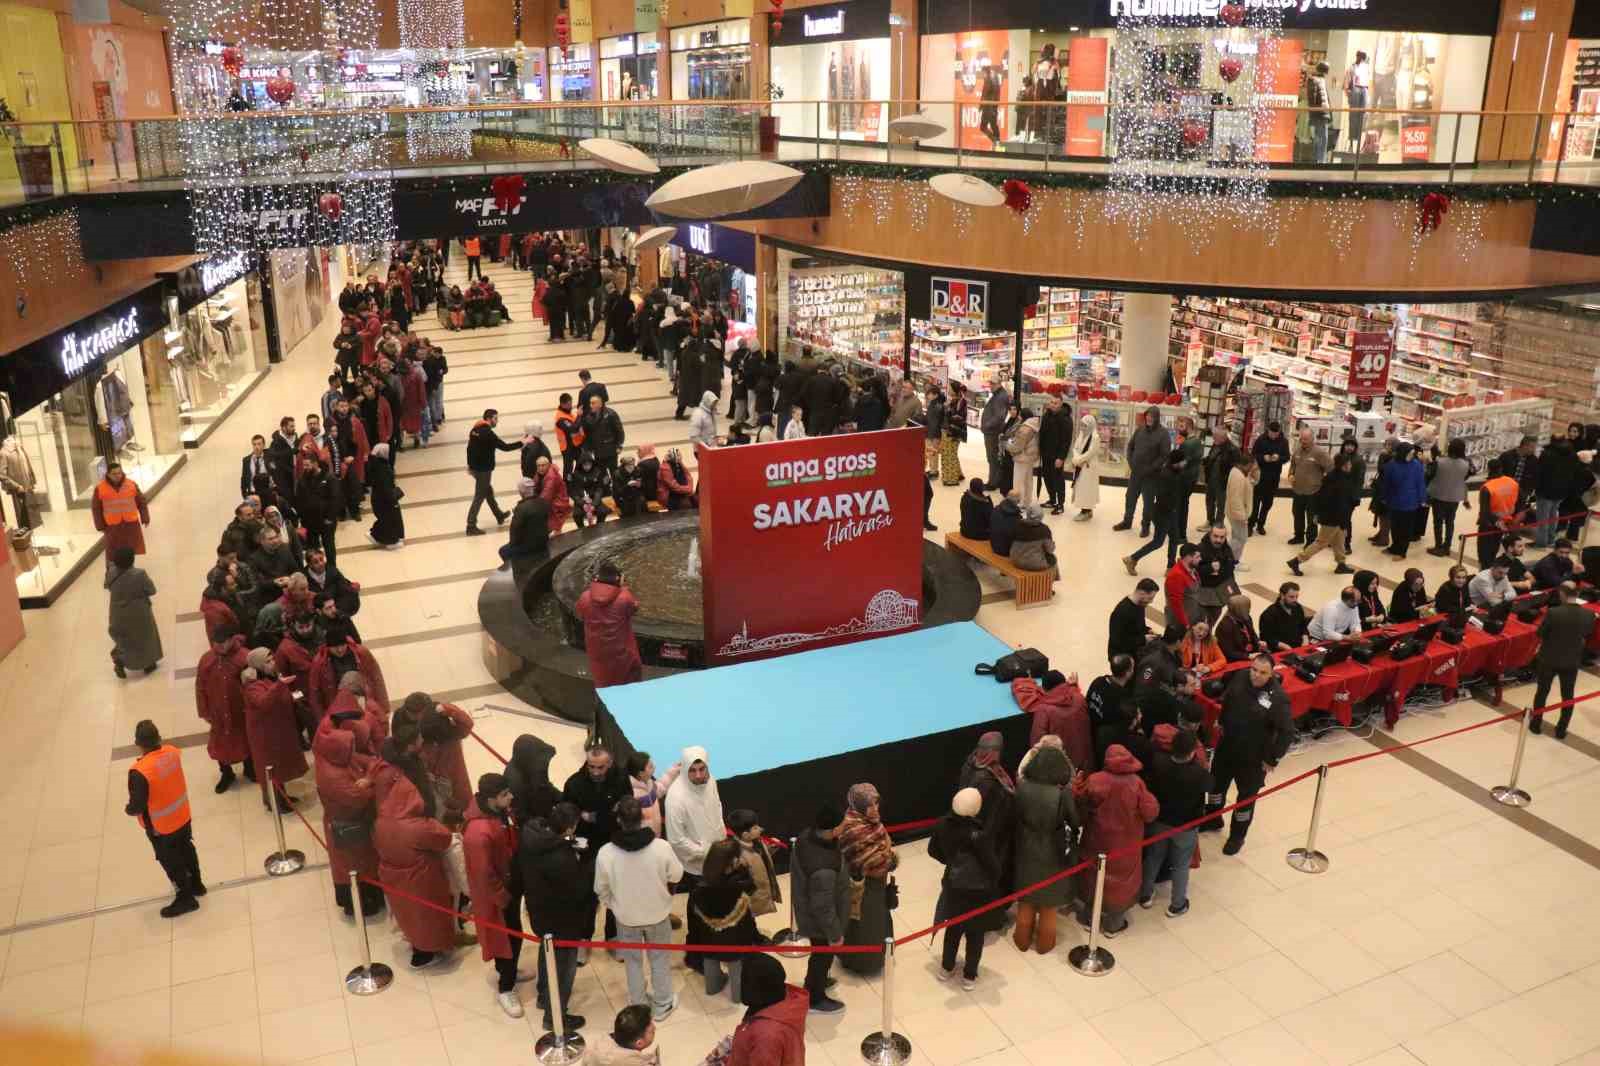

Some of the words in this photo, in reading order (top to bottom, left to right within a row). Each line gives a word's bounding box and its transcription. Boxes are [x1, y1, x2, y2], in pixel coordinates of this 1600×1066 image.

[934, 289, 982, 315] D&R
[765, 458, 819, 484] anpa
[824, 452, 877, 481] gross
[753, 489, 890, 530] SAKARYA
